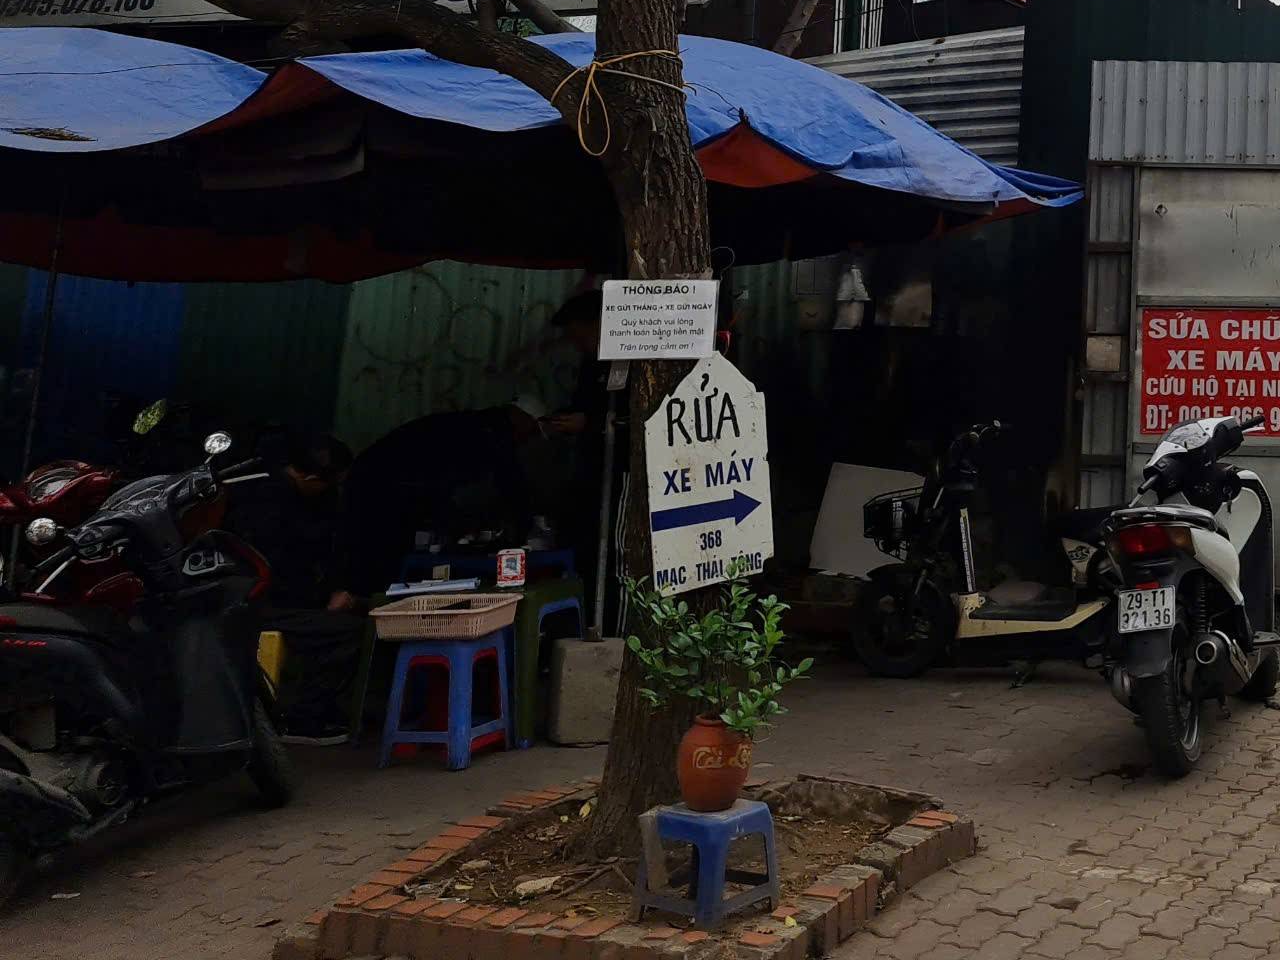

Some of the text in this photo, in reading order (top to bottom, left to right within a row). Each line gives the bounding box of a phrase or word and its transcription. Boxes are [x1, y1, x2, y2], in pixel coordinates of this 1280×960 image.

[622, 283, 661, 295] THÔNG
[664, 283, 690, 294] BÁO
[633, 302, 658, 311] THÁNG
[609, 329, 632, 337] thanh
[1148, 312, 1210, 340] SỬA
[619, 343, 637, 352] Trân
[1166, 350, 1205, 370] XE
[1146, 374, 1186, 396] CỨU
[1192, 374, 1219, 401] HỘ
[1225, 378, 1256, 401] TẠI
[666, 373, 740, 447] RỬA
[1145, 404, 1173, 430] ĐT:
[663, 450, 754, 496] XE MÁY
[699, 529, 722, 551] 368
[656, 565, 687, 591] MẠC
[696, 554, 724, 582] THÁI
[1126, 590, 1167, 611] 29-T1
